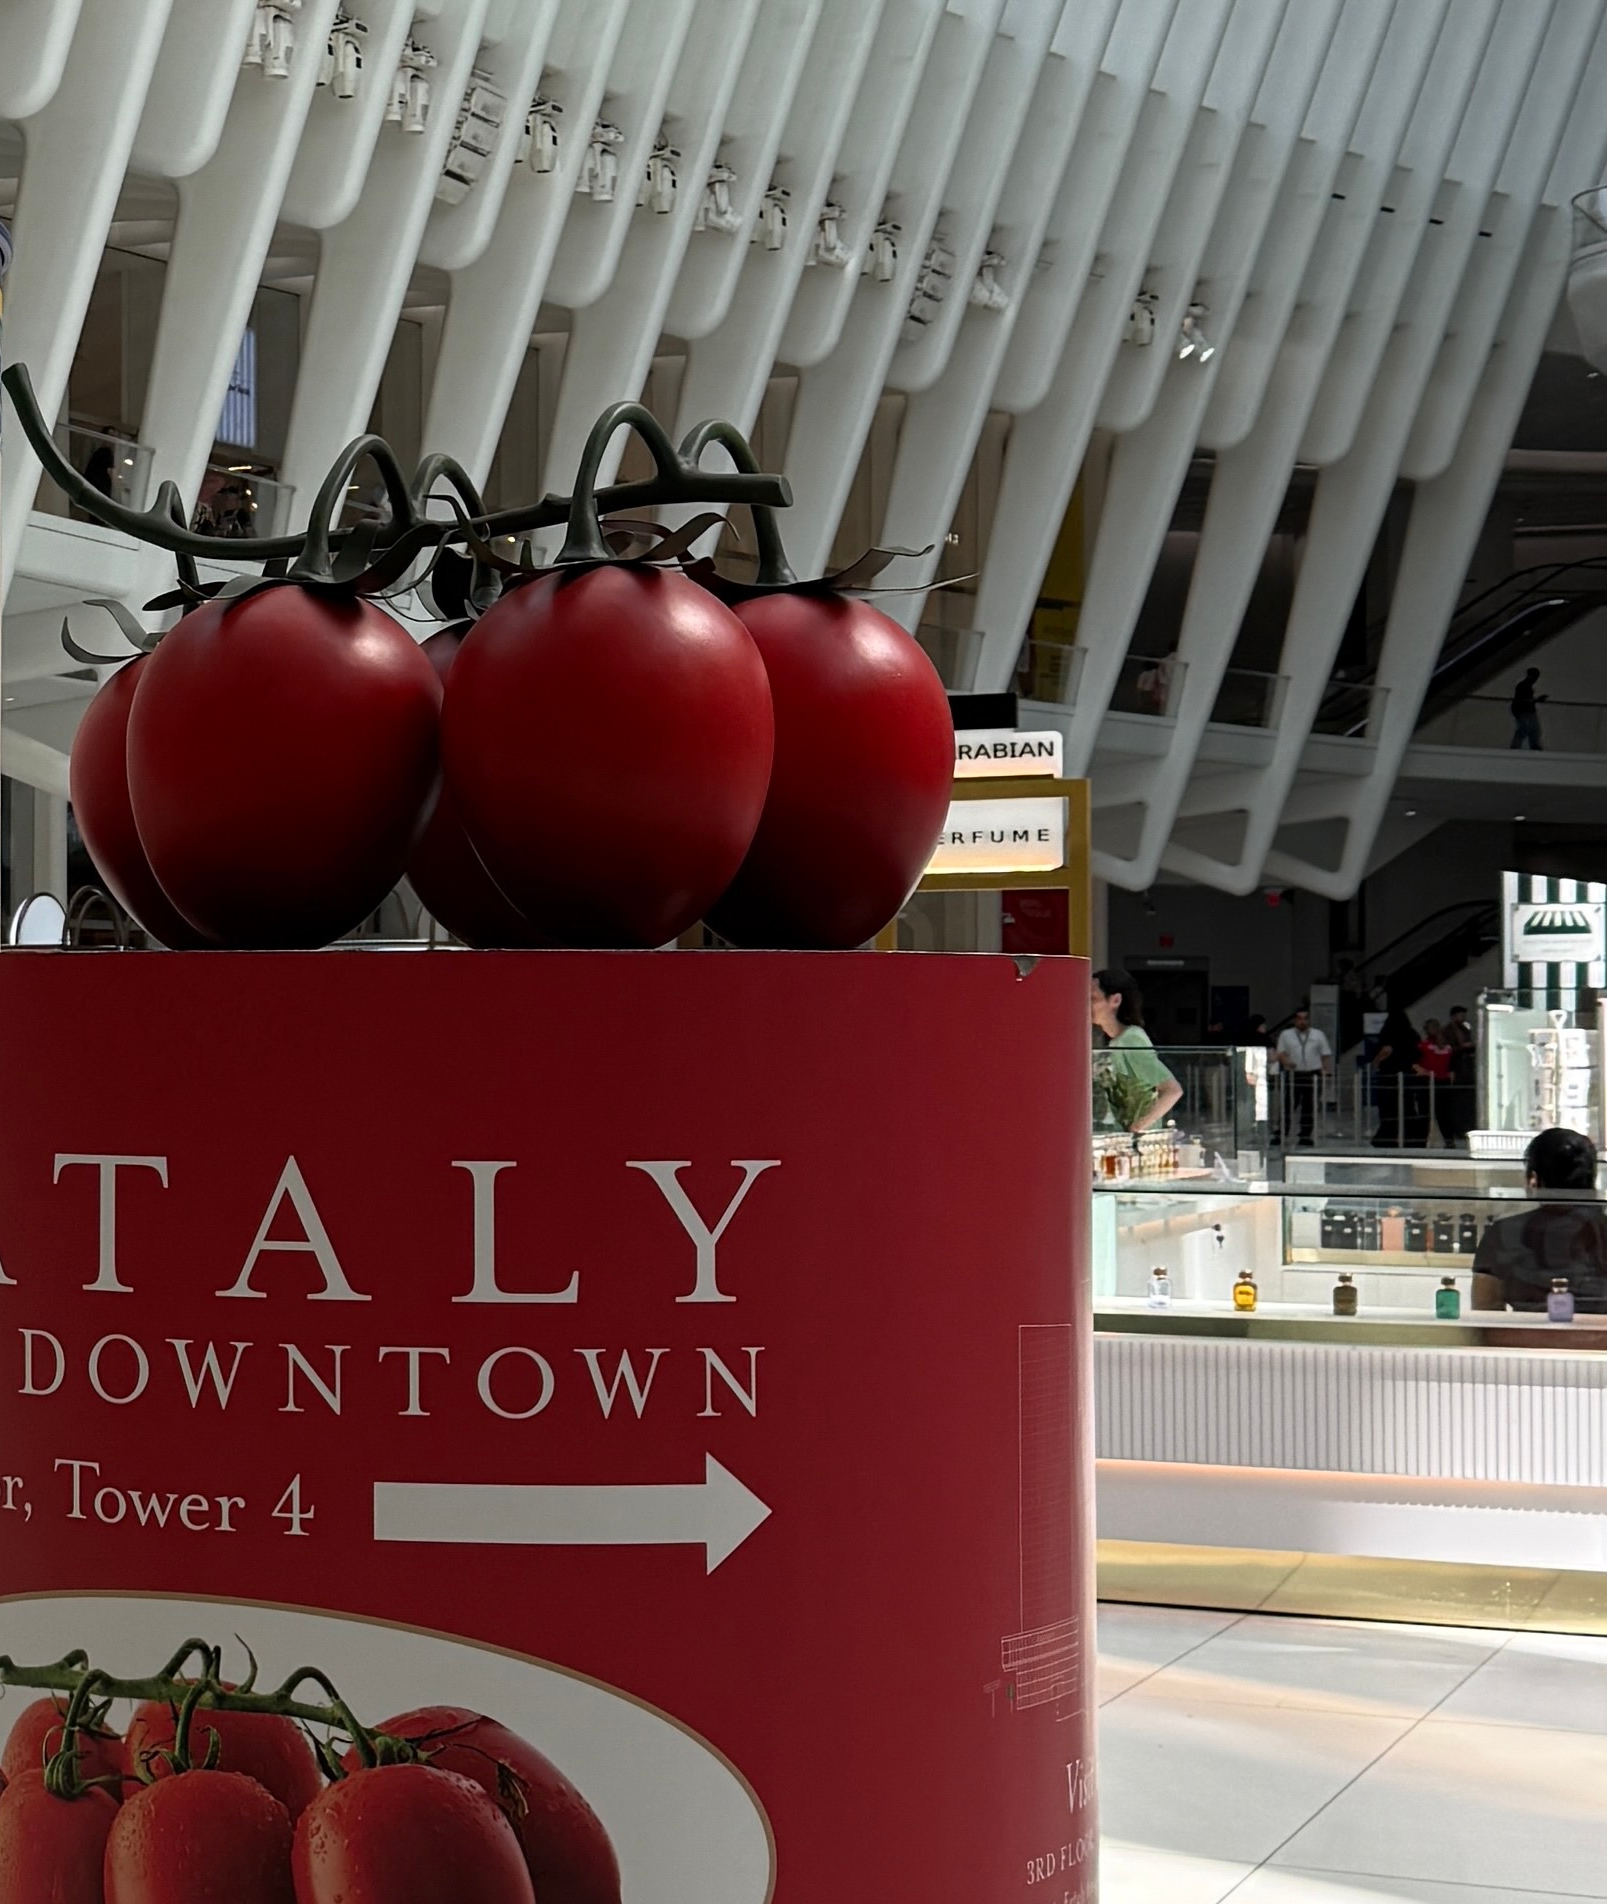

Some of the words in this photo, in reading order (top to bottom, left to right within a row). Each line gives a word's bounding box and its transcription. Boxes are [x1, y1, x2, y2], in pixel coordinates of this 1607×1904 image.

[955, 741, 1054, 760] RABIAN
[938, 829, 1050, 845] ERFUME
[17, 1328, 765, 1419] DOWNTOWN
[53, 1459, 245, 1531] Tower
[272, 1473, 314, 1536] 4
[1027, 1853, 1056, 1885] 3RD
